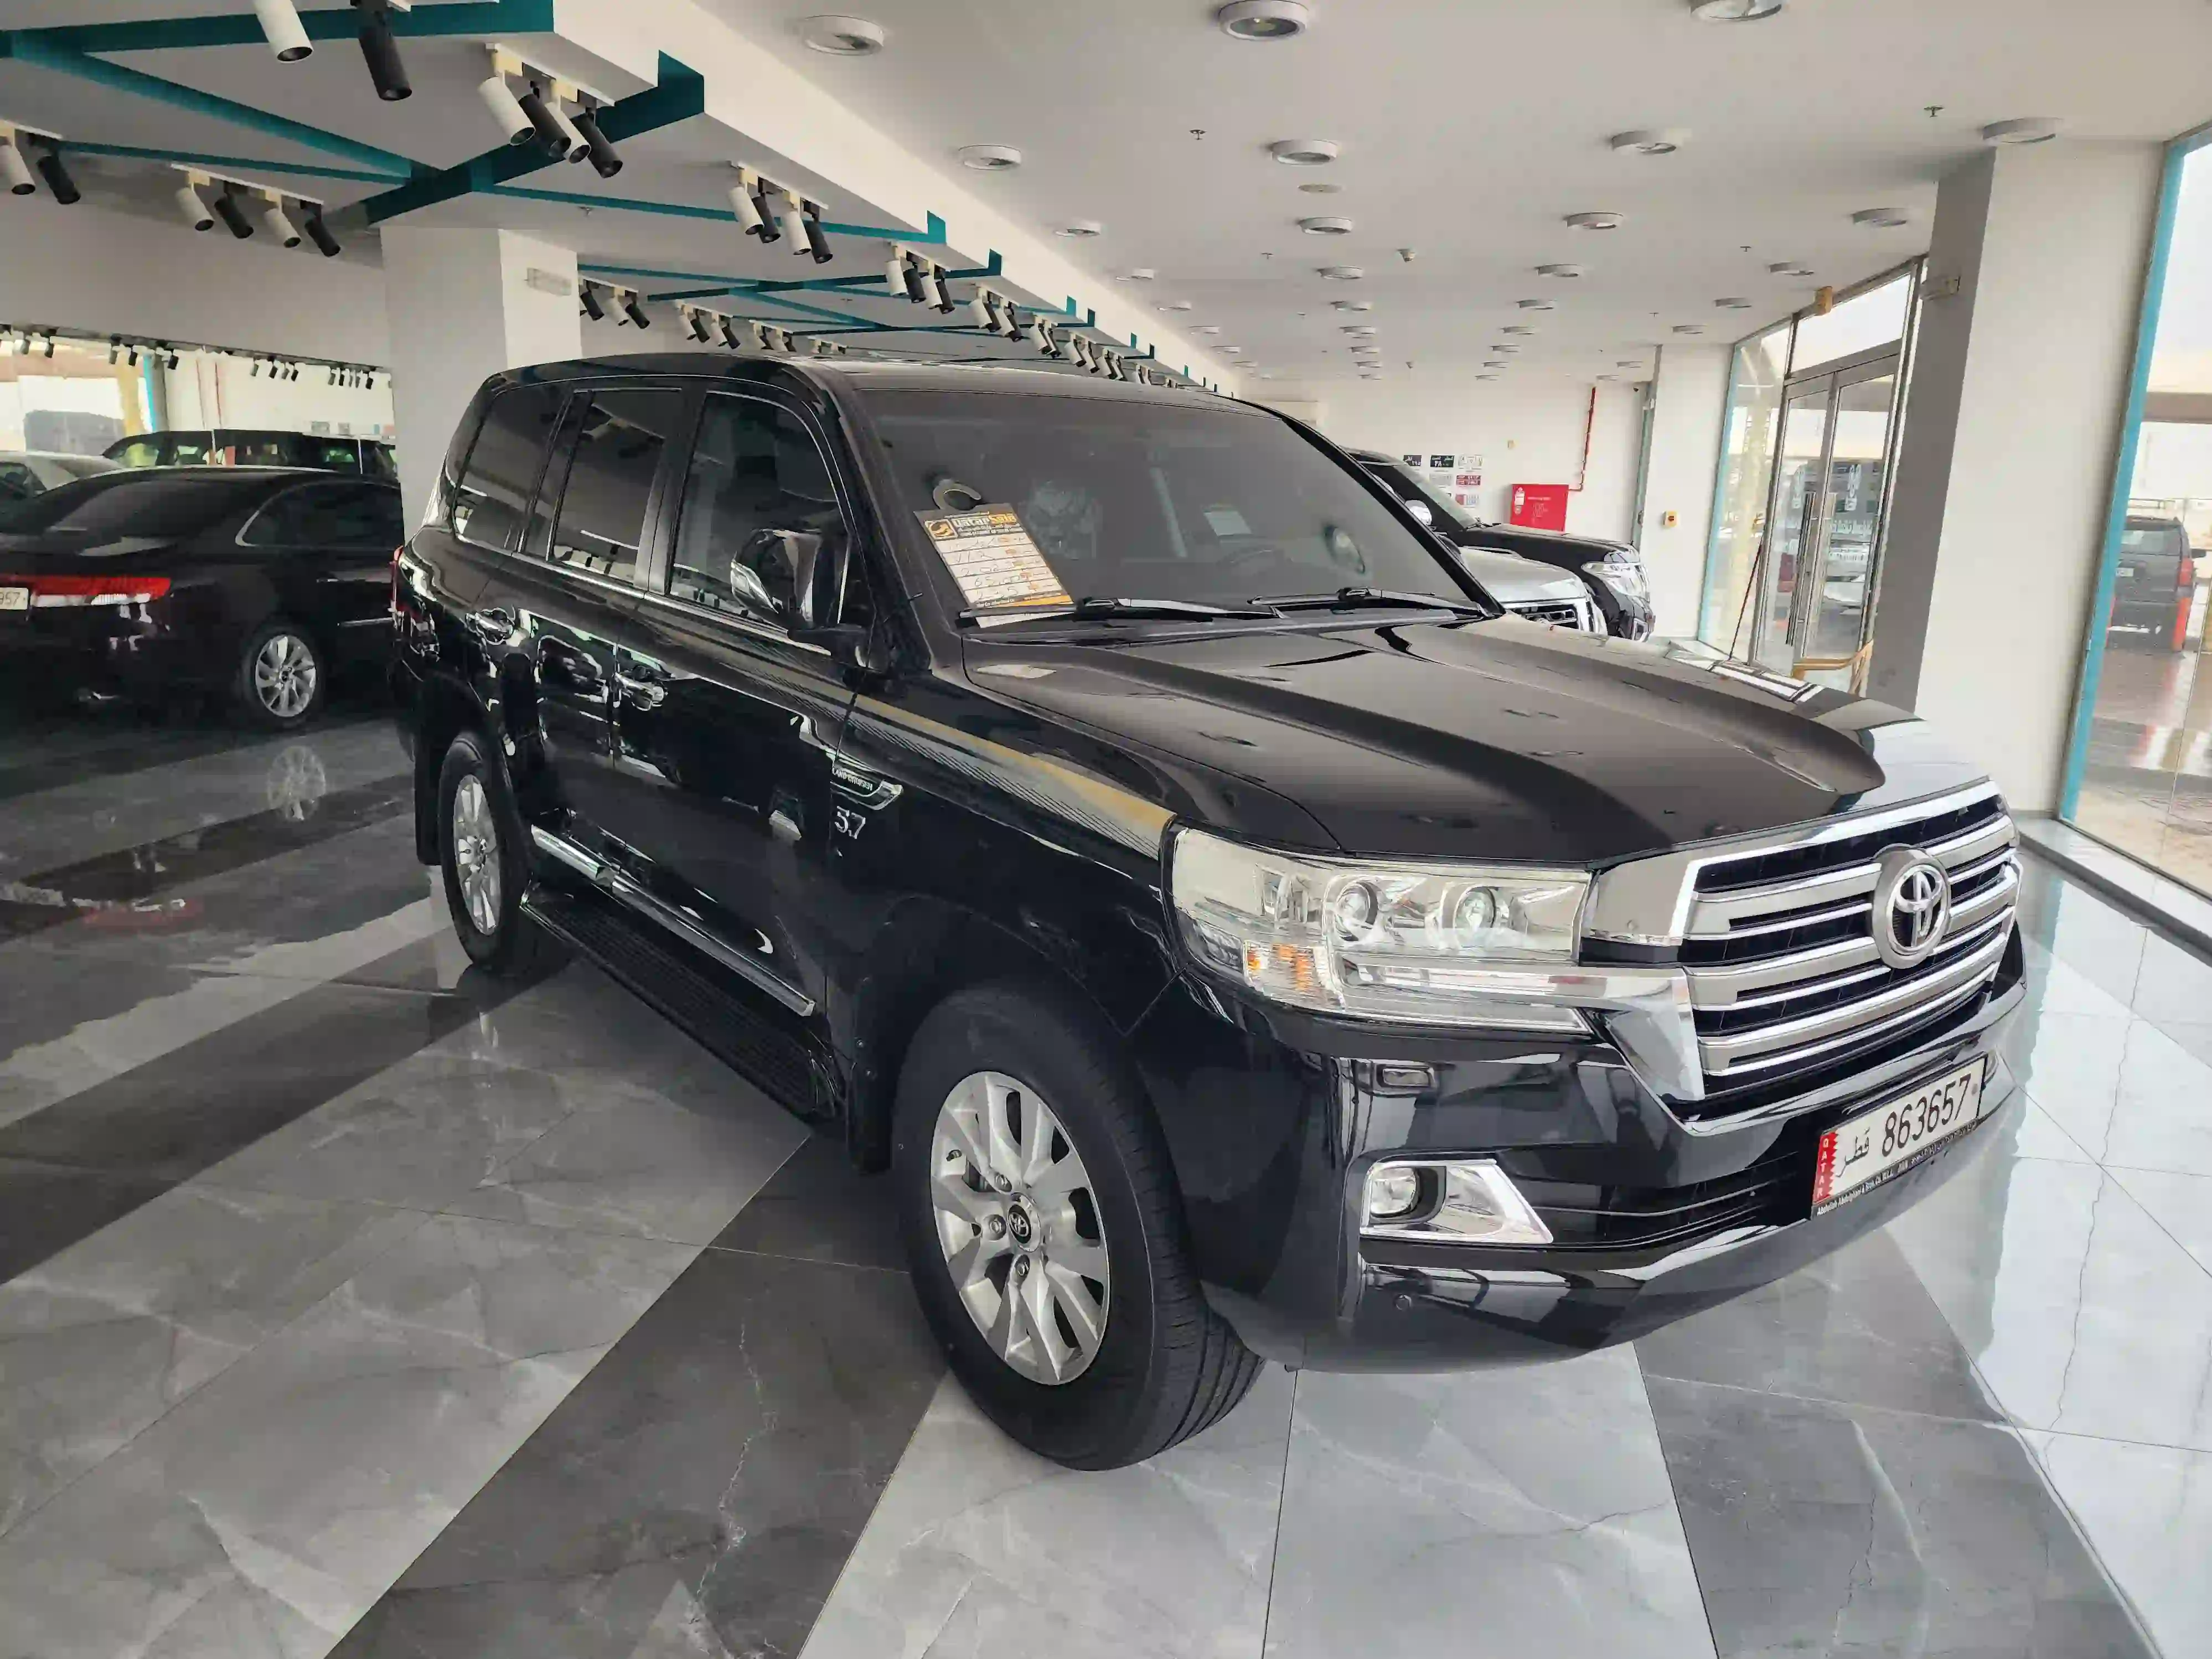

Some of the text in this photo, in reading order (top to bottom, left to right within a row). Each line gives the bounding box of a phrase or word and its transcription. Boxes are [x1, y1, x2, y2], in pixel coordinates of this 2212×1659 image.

[832, 767, 847, 779] LAND
[1882, 1072, 1971, 1157] 863657
[1816, 1138, 1829, 1198] QATAR
[1836, 1126, 1870, 1178] قطر
